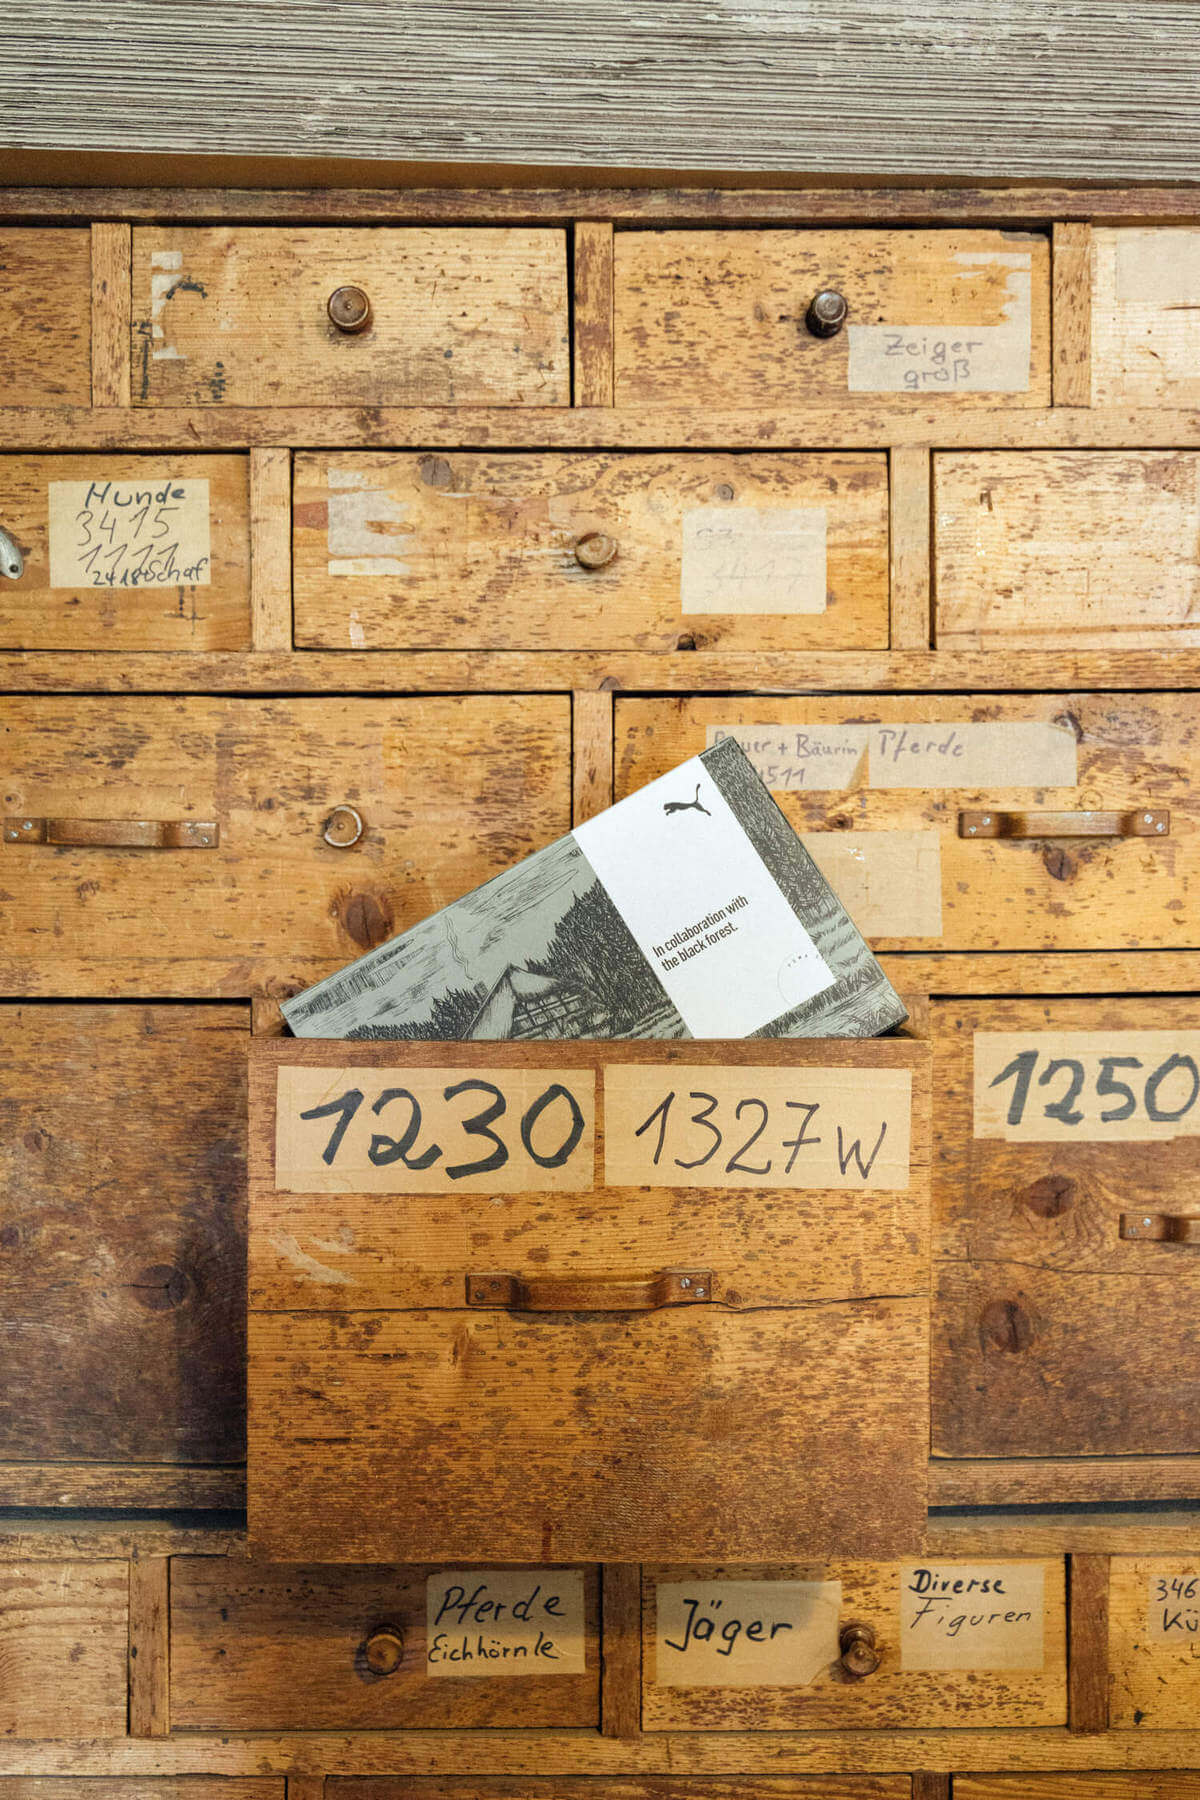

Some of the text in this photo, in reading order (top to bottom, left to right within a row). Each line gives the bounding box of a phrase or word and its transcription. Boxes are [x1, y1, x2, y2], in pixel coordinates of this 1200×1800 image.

[883, 334, 983, 364] Zeiger
[904, 360, 970, 389] groß
[85, 482, 186, 509] Hunde
[76, 506, 180, 546] 3415
[714, 731, 772, 753] uer
[796, 733, 858, 759] Bäurin
[879, 729, 964, 762] Pferde
[760, 765, 806, 787] 511
[652, 895, 749, 958] In collaboration with
[661, 921, 739, 972] the black forest.
[988, 1048, 1200, 1126] 1250
[300, 1079, 586, 1180] 1230
[908, 1569, 1006, 1594] Diverse
[434, 1585, 566, 1627] Pferde
[910, 1596, 1032, 1637] Figuren
[665, 1599, 793, 1656] Jäger
[428, 1631, 559, 1663] Eichhörnle
